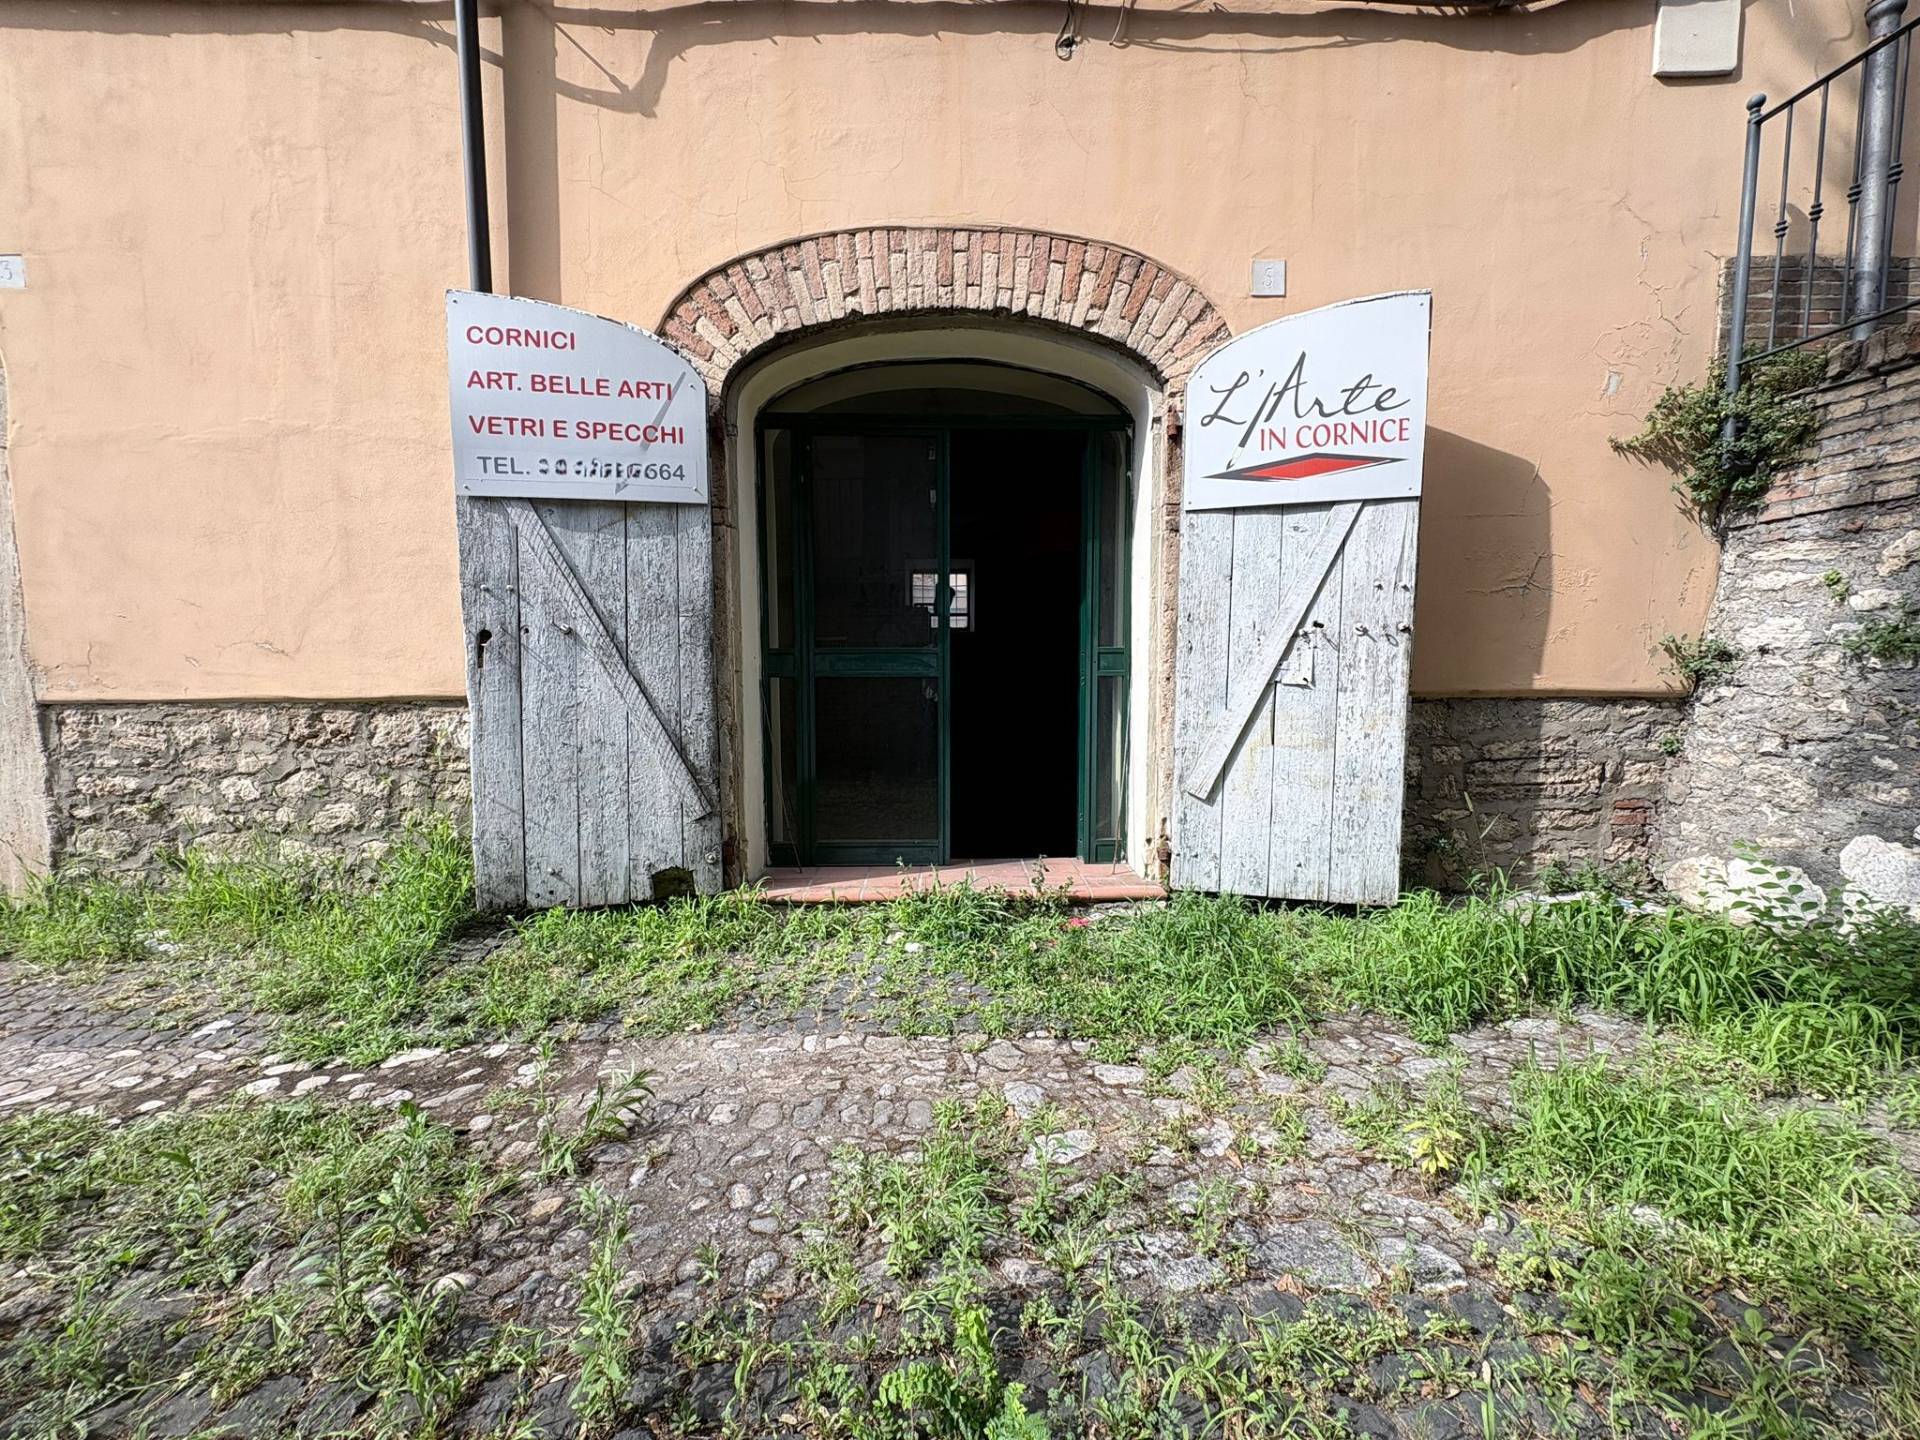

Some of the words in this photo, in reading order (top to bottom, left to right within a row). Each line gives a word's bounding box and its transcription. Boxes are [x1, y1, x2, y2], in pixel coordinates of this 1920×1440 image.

[466, 326, 576, 350] CORNICI
[467, 370, 522, 391] ART.
[531, 374, 610, 396] BELLE
[617, 380, 672, 400] ARTI
[1201, 351, 1411, 427] L'Arte
[469, 415, 544, 437] VETRI
[553, 420, 568, 437] E
[576, 421, 684, 444] SPECCHI
[1260, 427, 1287, 451] IN
[1296, 418, 1410, 449] CORNICE
[477, 456, 530, 475] TEL.
